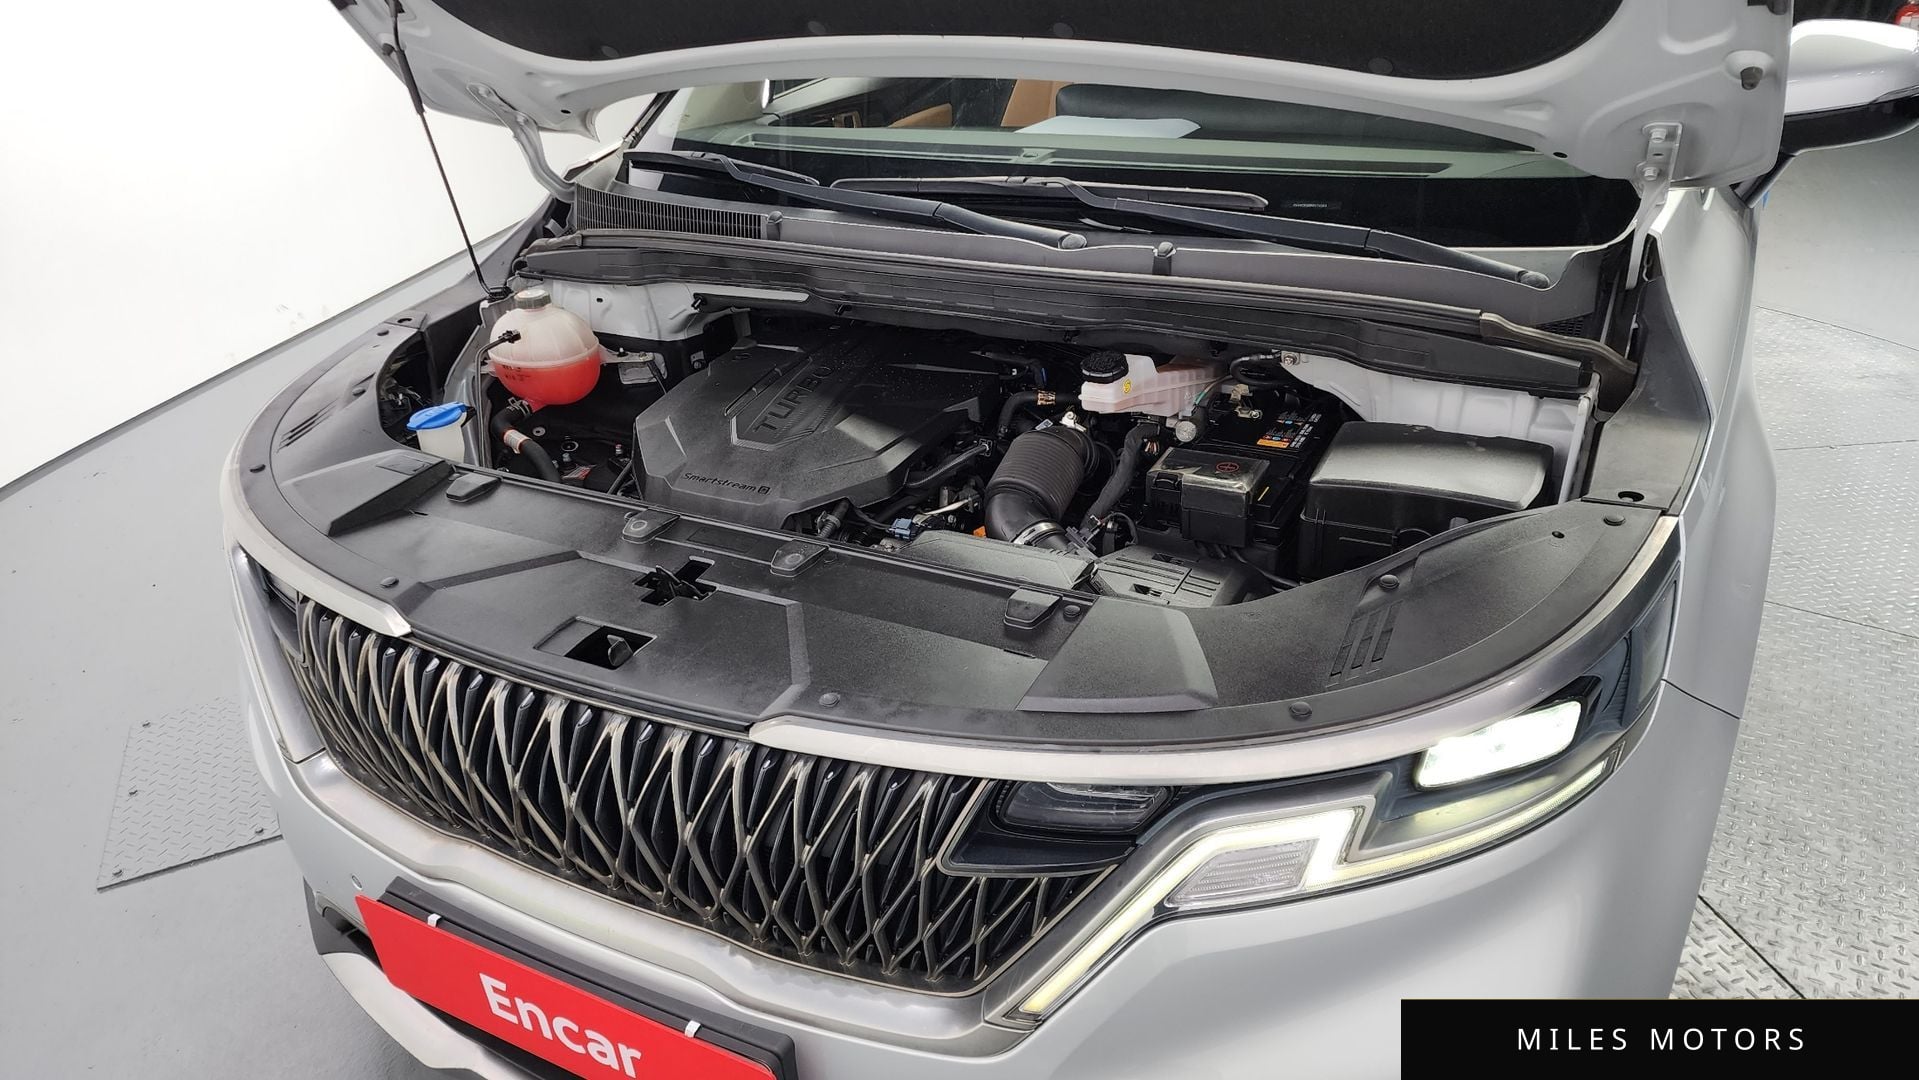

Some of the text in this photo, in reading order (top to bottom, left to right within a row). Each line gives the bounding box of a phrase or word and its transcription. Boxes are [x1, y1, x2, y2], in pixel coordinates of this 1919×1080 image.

[752, 366, 834, 433] TURBO
[683, 472, 757, 492] Smartstream
[479, 972, 642, 1079] Encar
